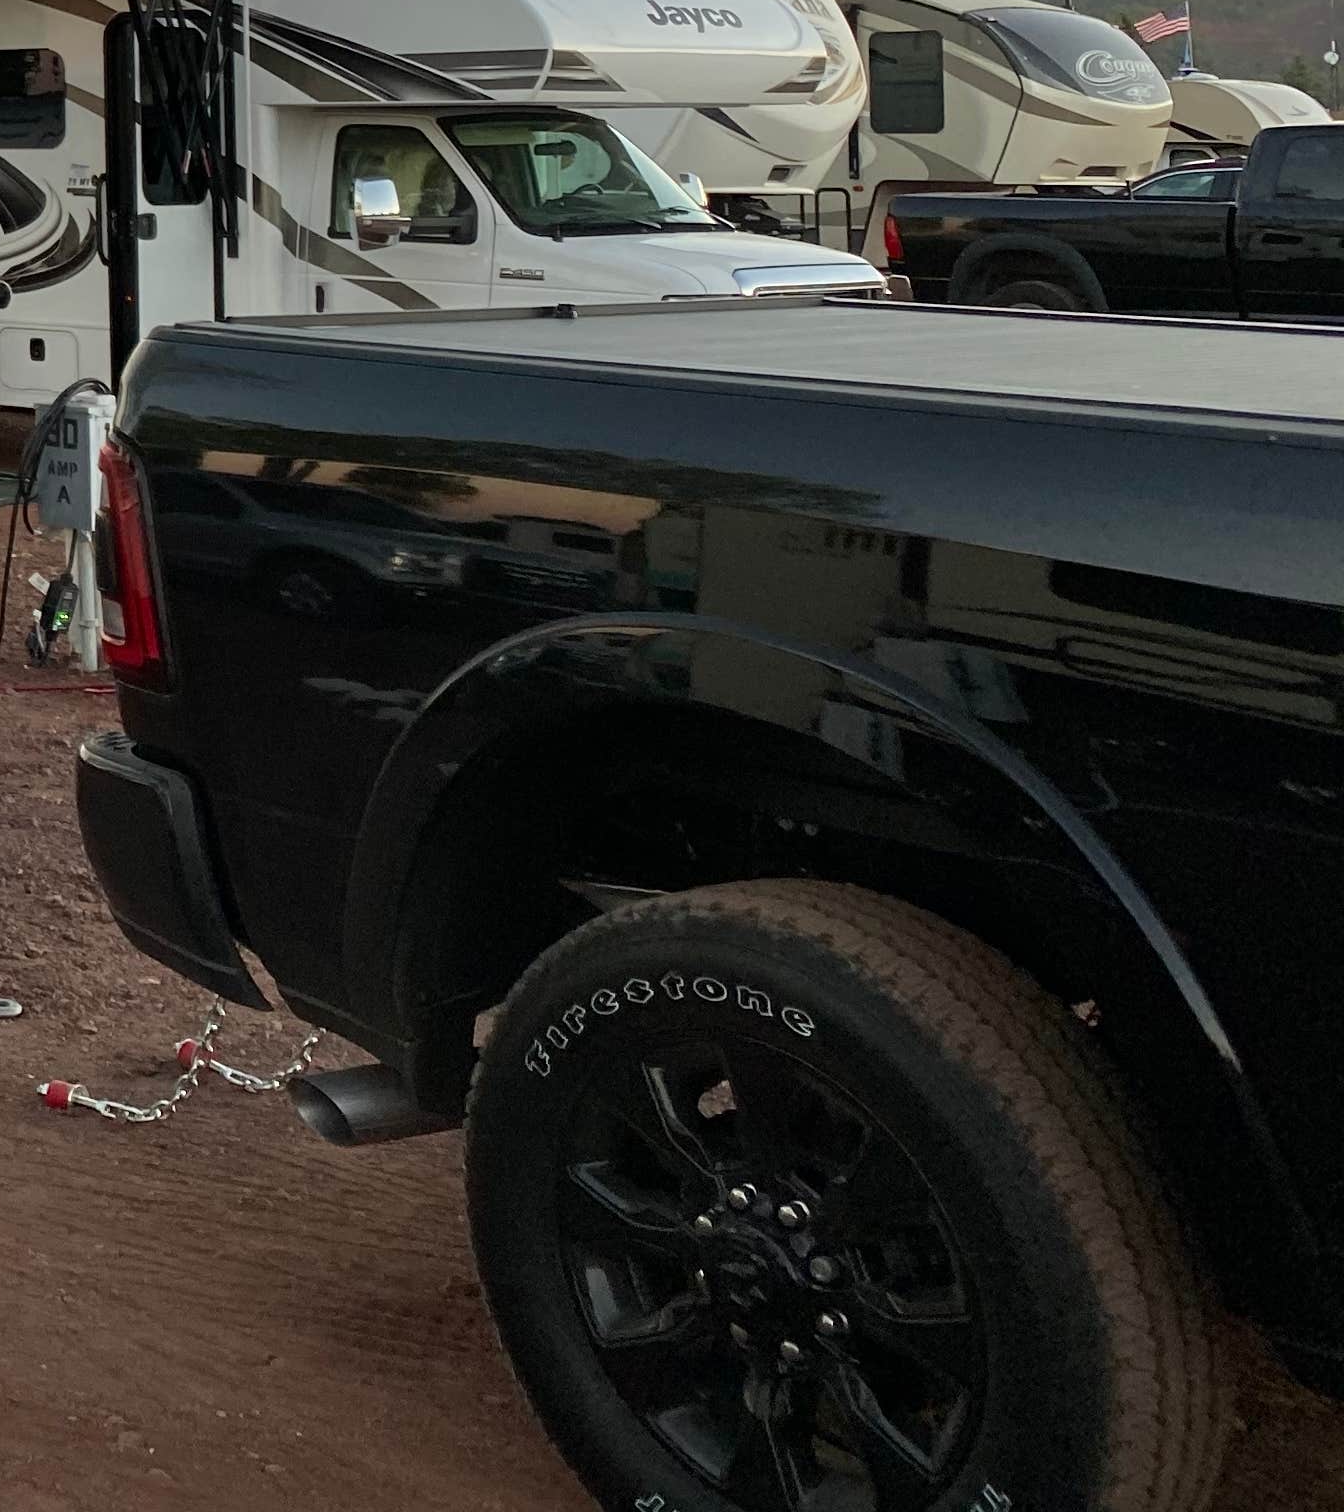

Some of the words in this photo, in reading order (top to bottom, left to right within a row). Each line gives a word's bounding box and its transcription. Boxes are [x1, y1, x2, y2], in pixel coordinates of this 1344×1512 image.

[646, 0, 743, 33] Jayco
[48, 460, 79, 478] AMP
[56, 485, 71, 505] A
[525, 973, 815, 1077] Firestone
